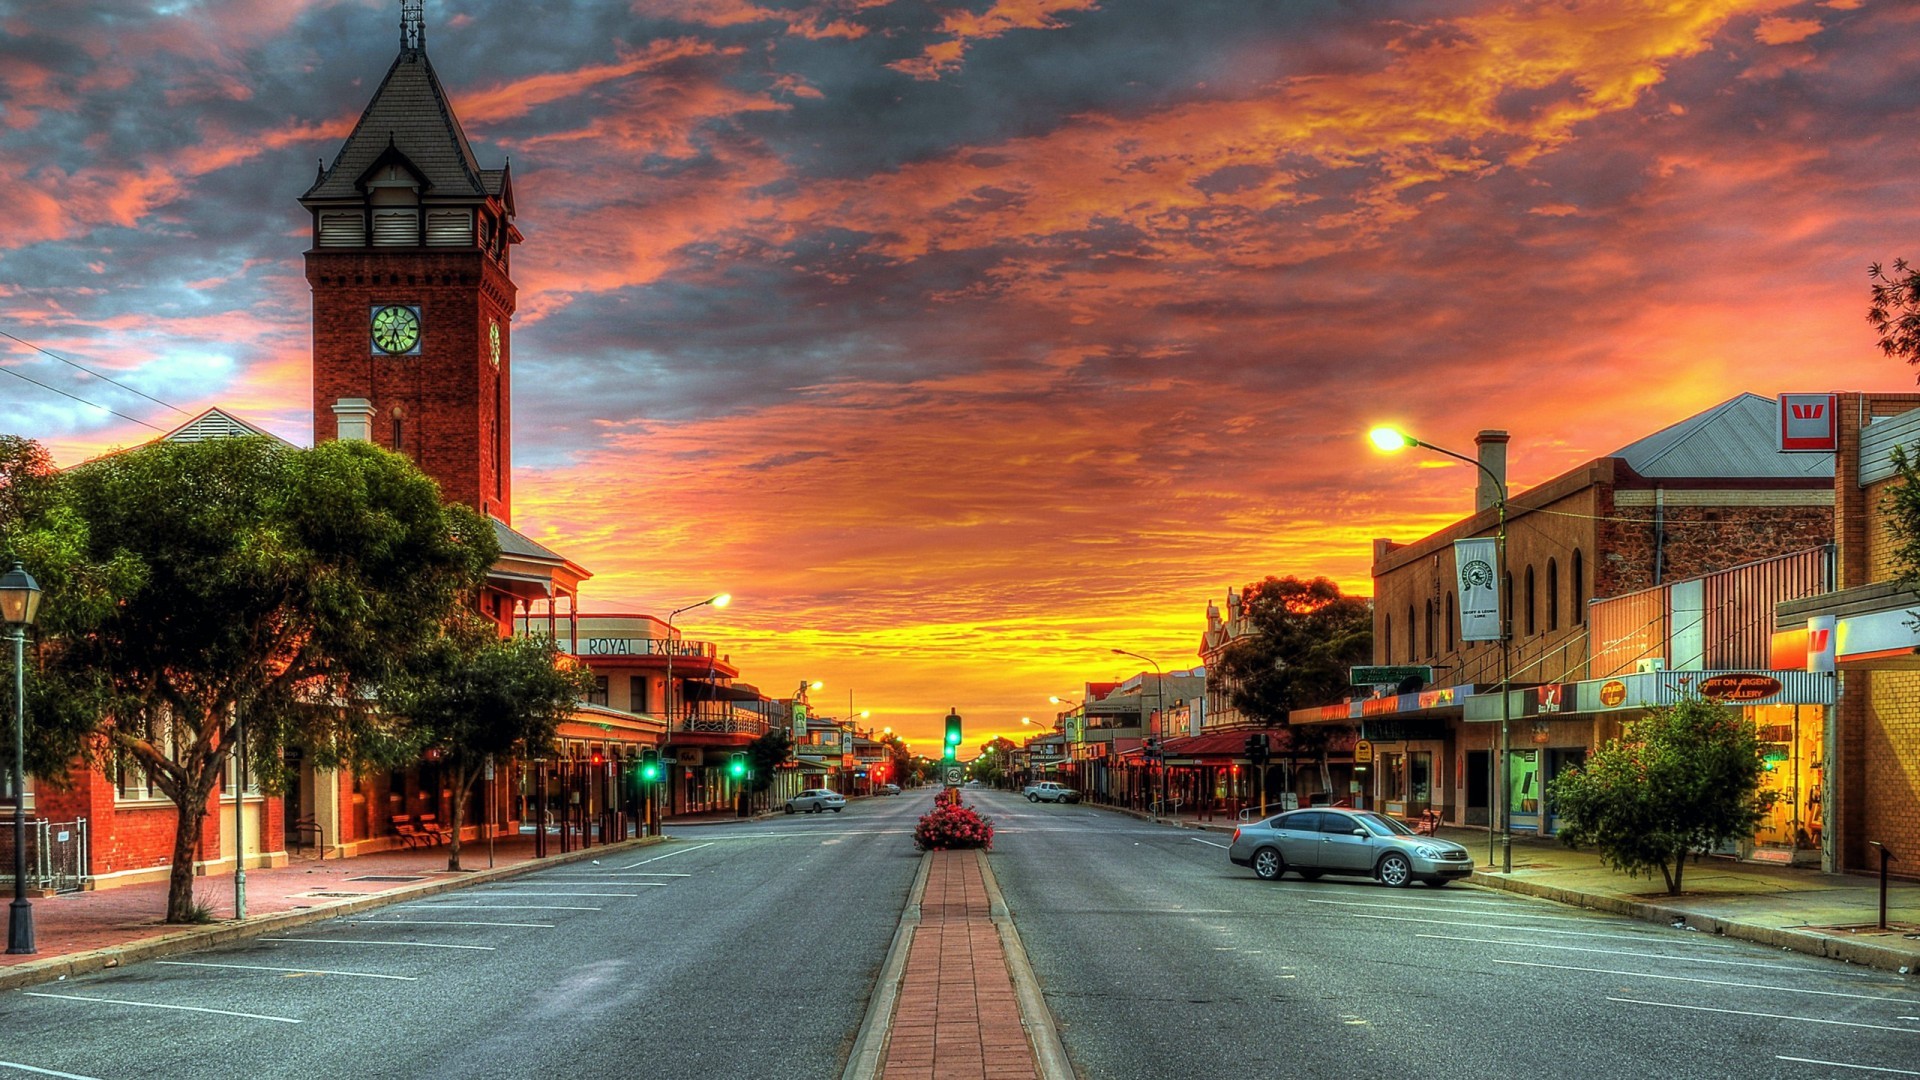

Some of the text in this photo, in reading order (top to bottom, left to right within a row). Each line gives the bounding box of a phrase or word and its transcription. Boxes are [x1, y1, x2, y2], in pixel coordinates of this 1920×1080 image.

[589, 638, 636, 655] ROYAL
[1704, 679, 1722, 689] ART
[1738, 678, 1773, 686] ARGENT
[1727, 690, 1763, 698] GALLERY
